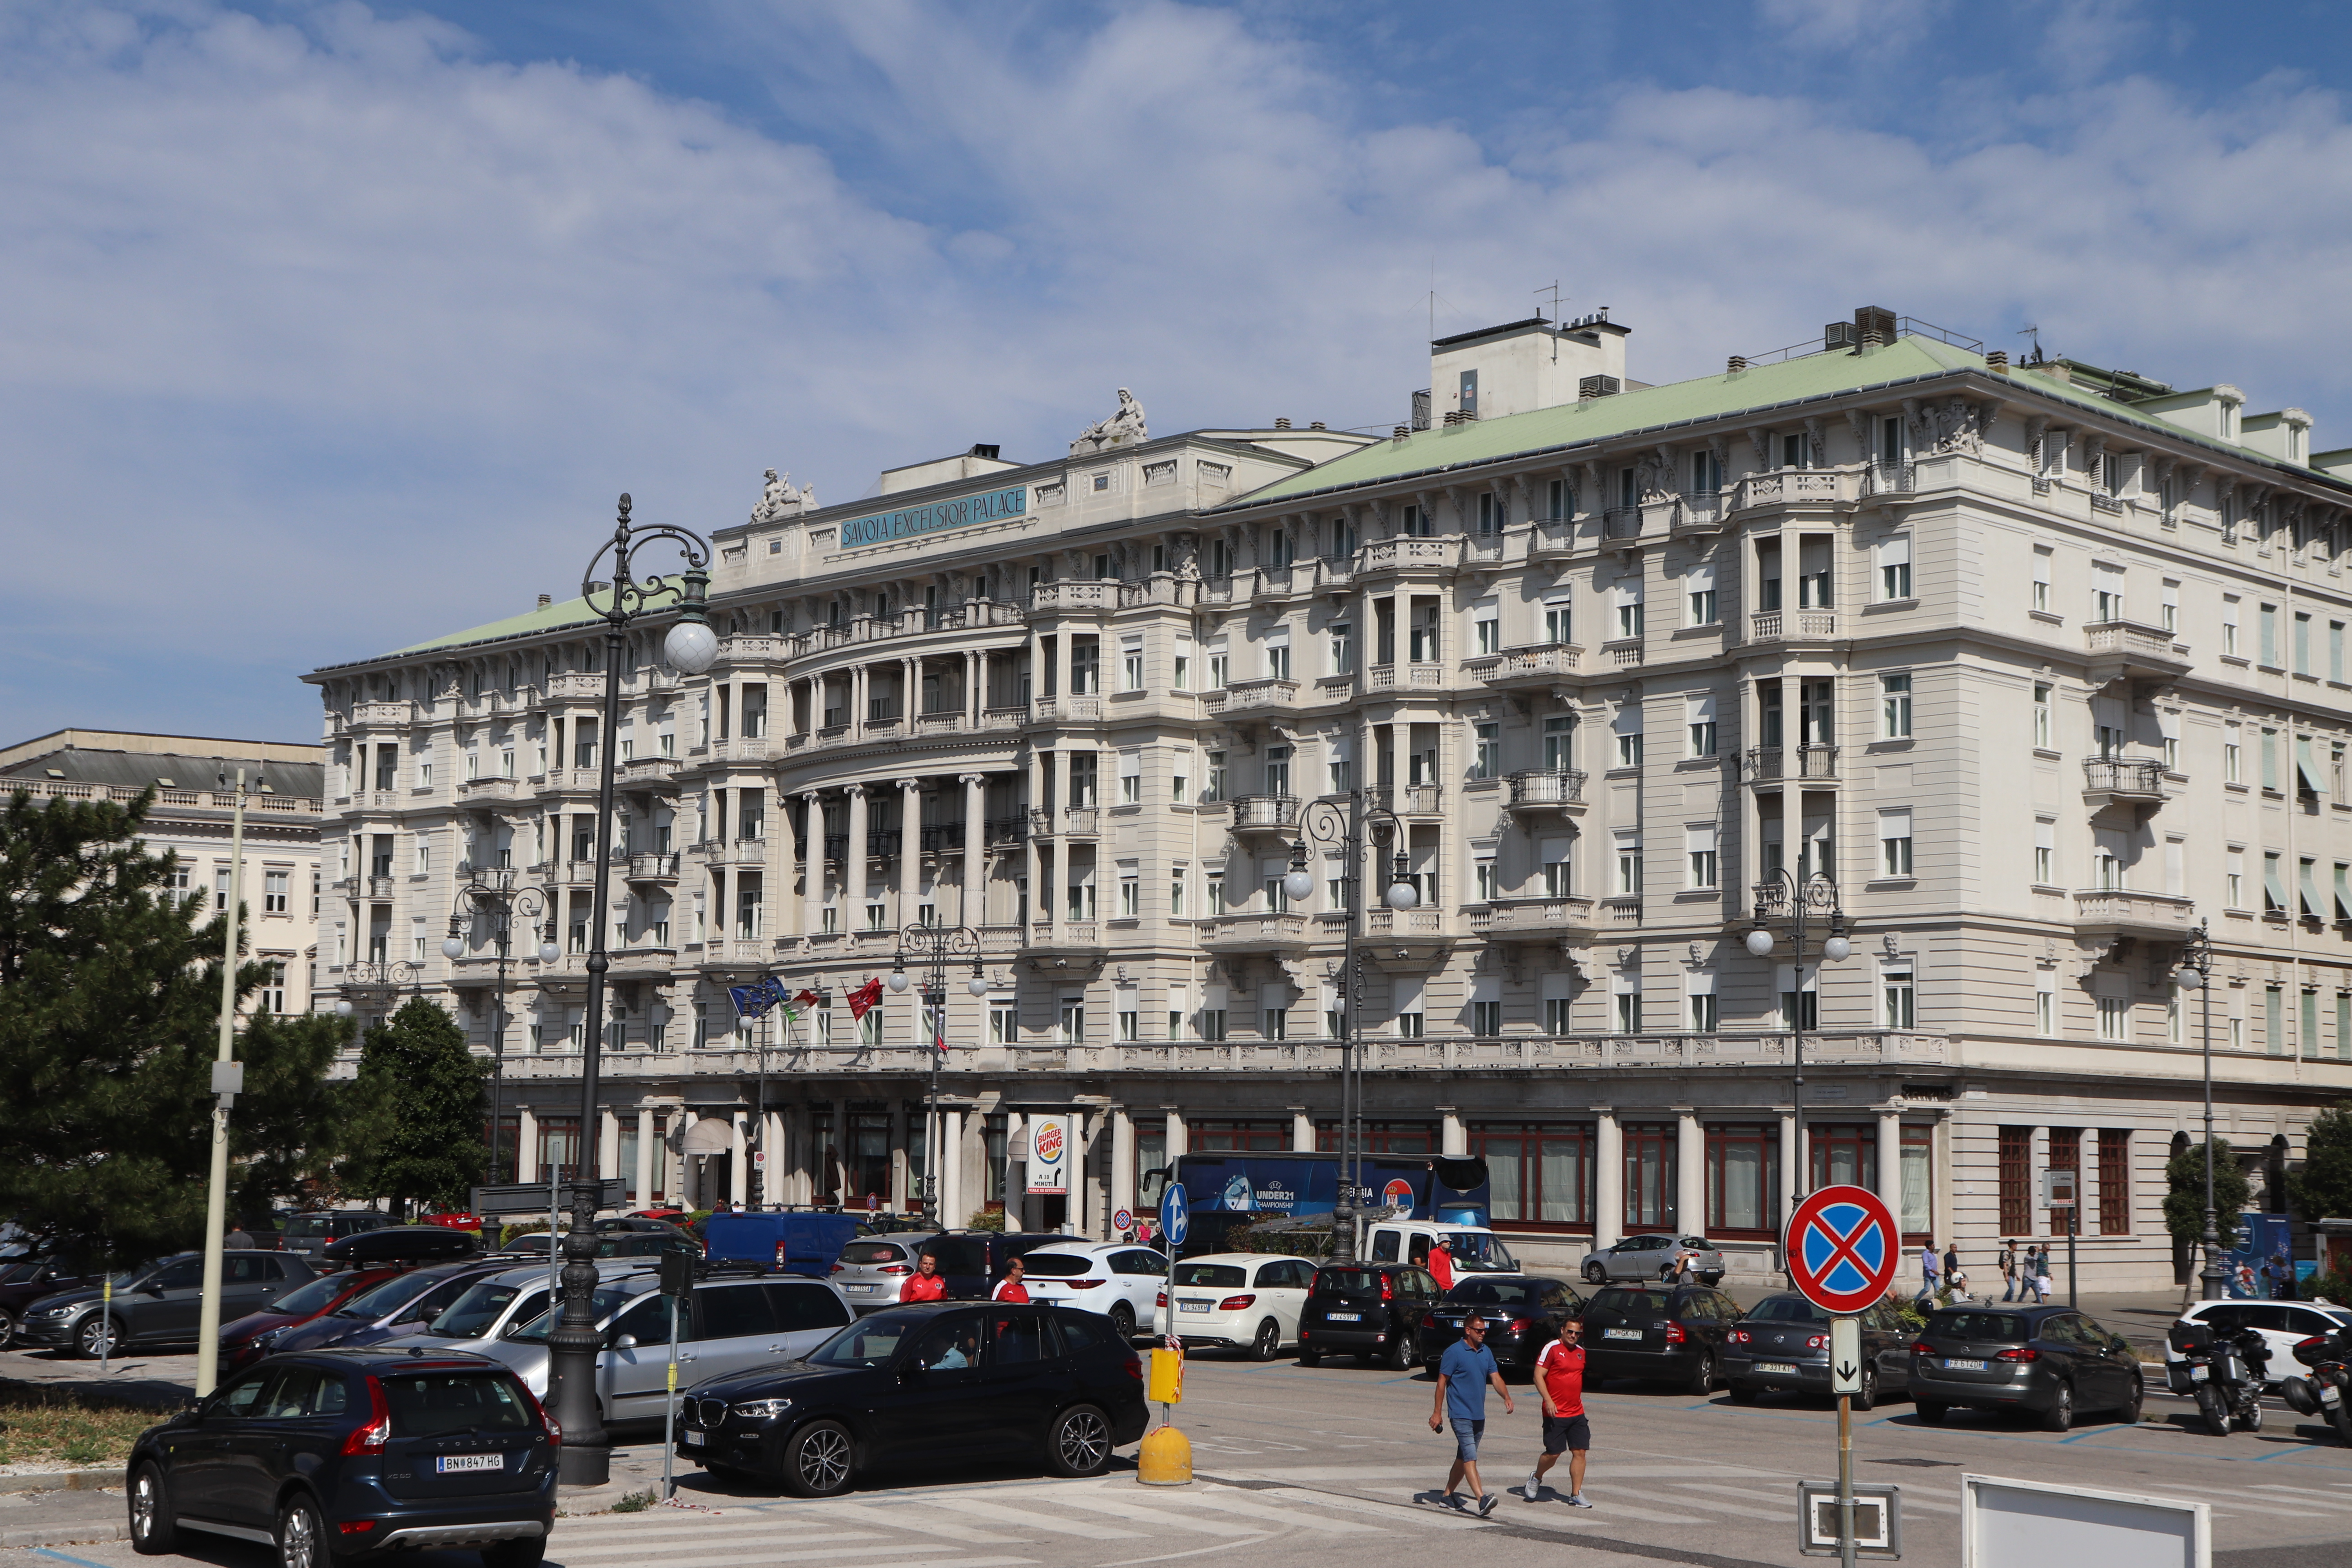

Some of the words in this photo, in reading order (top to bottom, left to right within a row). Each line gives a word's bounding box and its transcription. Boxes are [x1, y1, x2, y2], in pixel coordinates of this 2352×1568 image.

[843, 517, 889, 545] SAVOIA
[894, 501, 967, 536] EXCELSIOR
[973, 489, 1025, 521] PALACE
[1038, 1128, 1062, 1145] BURGER
[1039, 1136, 1062, 1156] KING
[1256, 1191, 1294, 1200] UNDER21
[1949, 1359, 1958, 1367] FR
[1961, 1359, 1983, 1369] 614DR
[437, 1439, 508, 1447] VOLVO
[446, 1458, 459, 1469] BN
[466, 1456, 485, 1468] 847
[487, 1455, 500, 1466] HG
